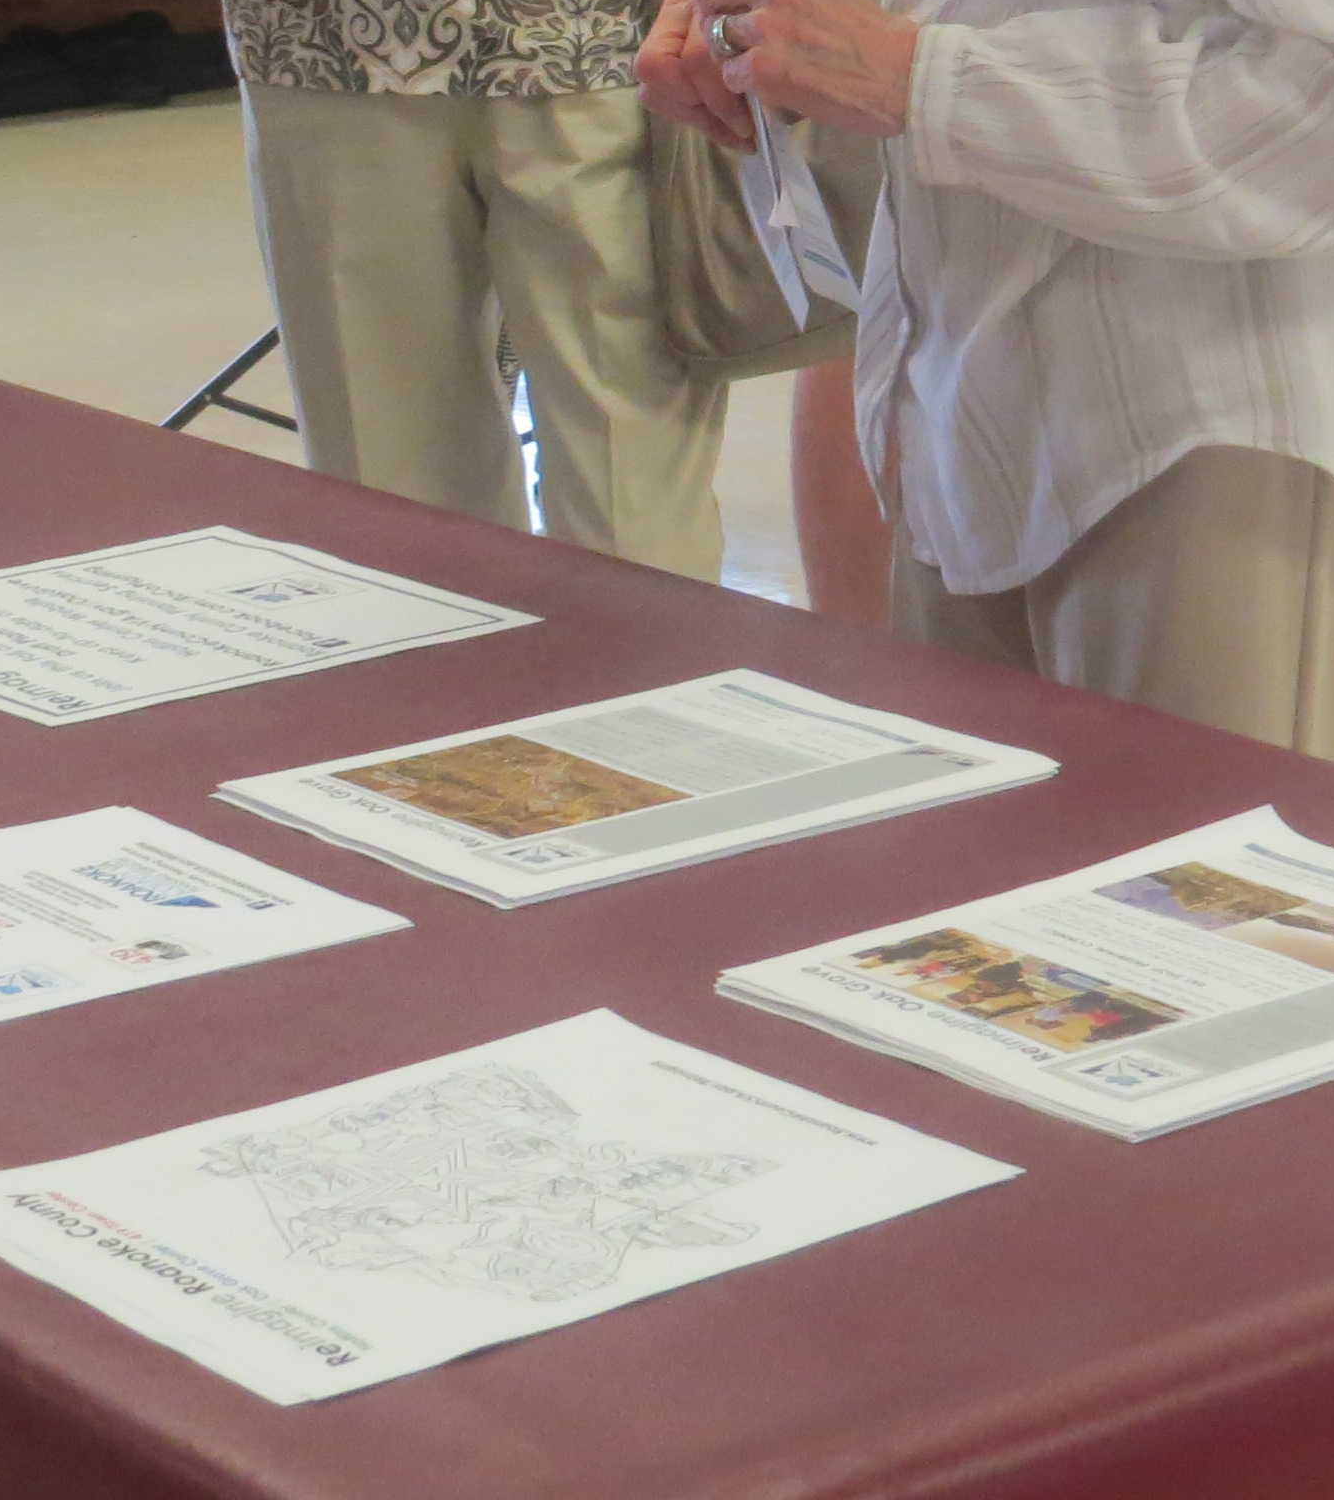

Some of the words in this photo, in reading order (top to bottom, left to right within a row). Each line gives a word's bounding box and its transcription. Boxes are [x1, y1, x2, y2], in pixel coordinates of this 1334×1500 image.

[288, 777, 357, 800] Grove
[341, 797, 396, 814] Oak
[68, 864, 167, 902] ROANOKE
[105, 947, 161, 966] 419
[795, 963, 876, 993] Grove
[865, 989, 929, 1012] Oak
[917, 1007, 1063, 1062] Reimagine
[85, 1235, 217, 1296] Roanoke
[200, 1288, 369, 1368] Reimagine
